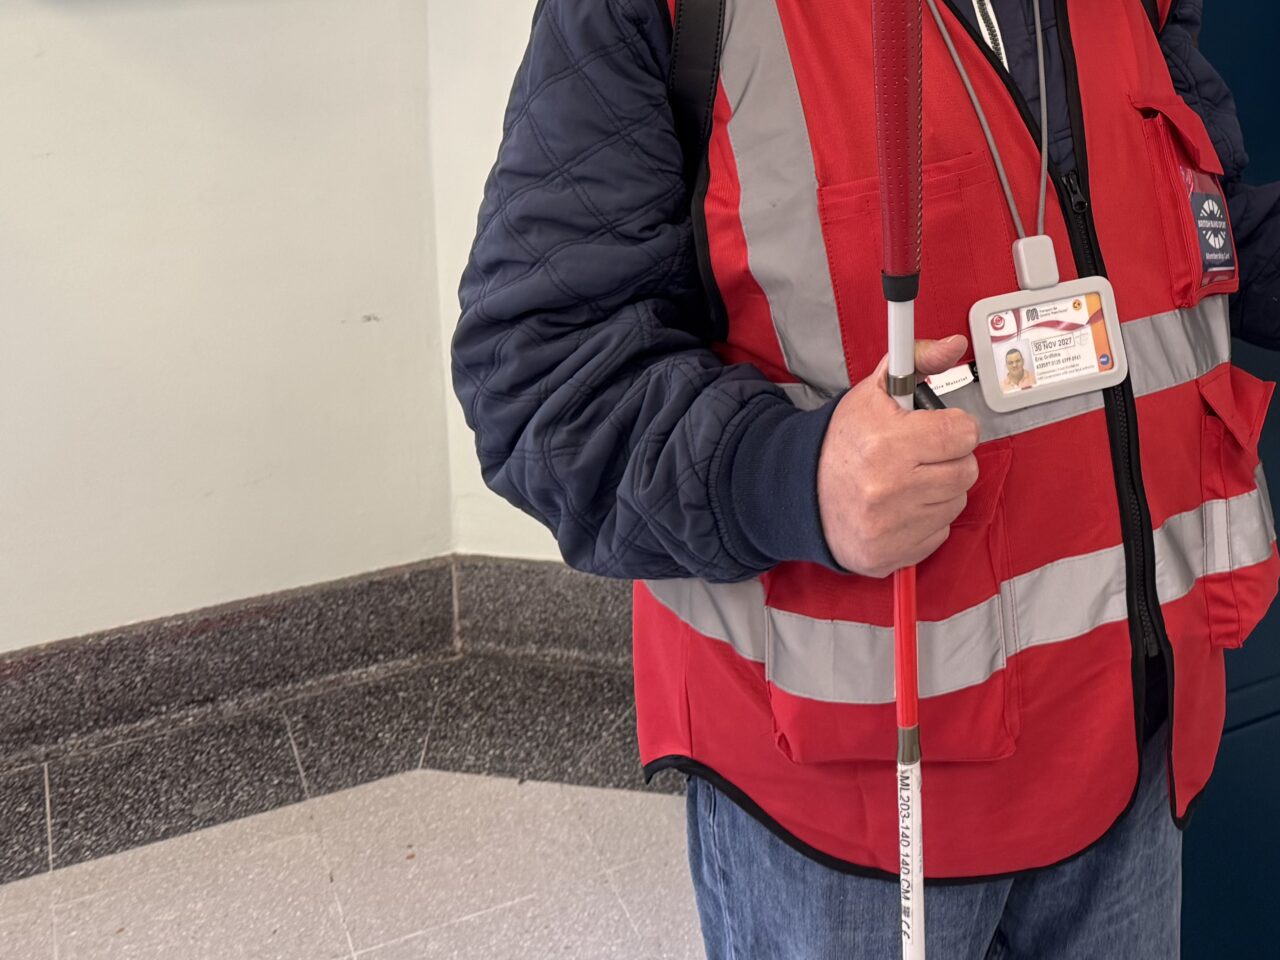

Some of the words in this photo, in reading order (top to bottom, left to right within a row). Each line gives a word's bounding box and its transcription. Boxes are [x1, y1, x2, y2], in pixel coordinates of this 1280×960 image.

[1034, 342, 1041, 352] 30
[1043, 341, 1057, 351] NOV
[1058, 337, 1072, 347] 2027
[900, 852, 910, 874] 140
[900, 878, 911, 900] CM
